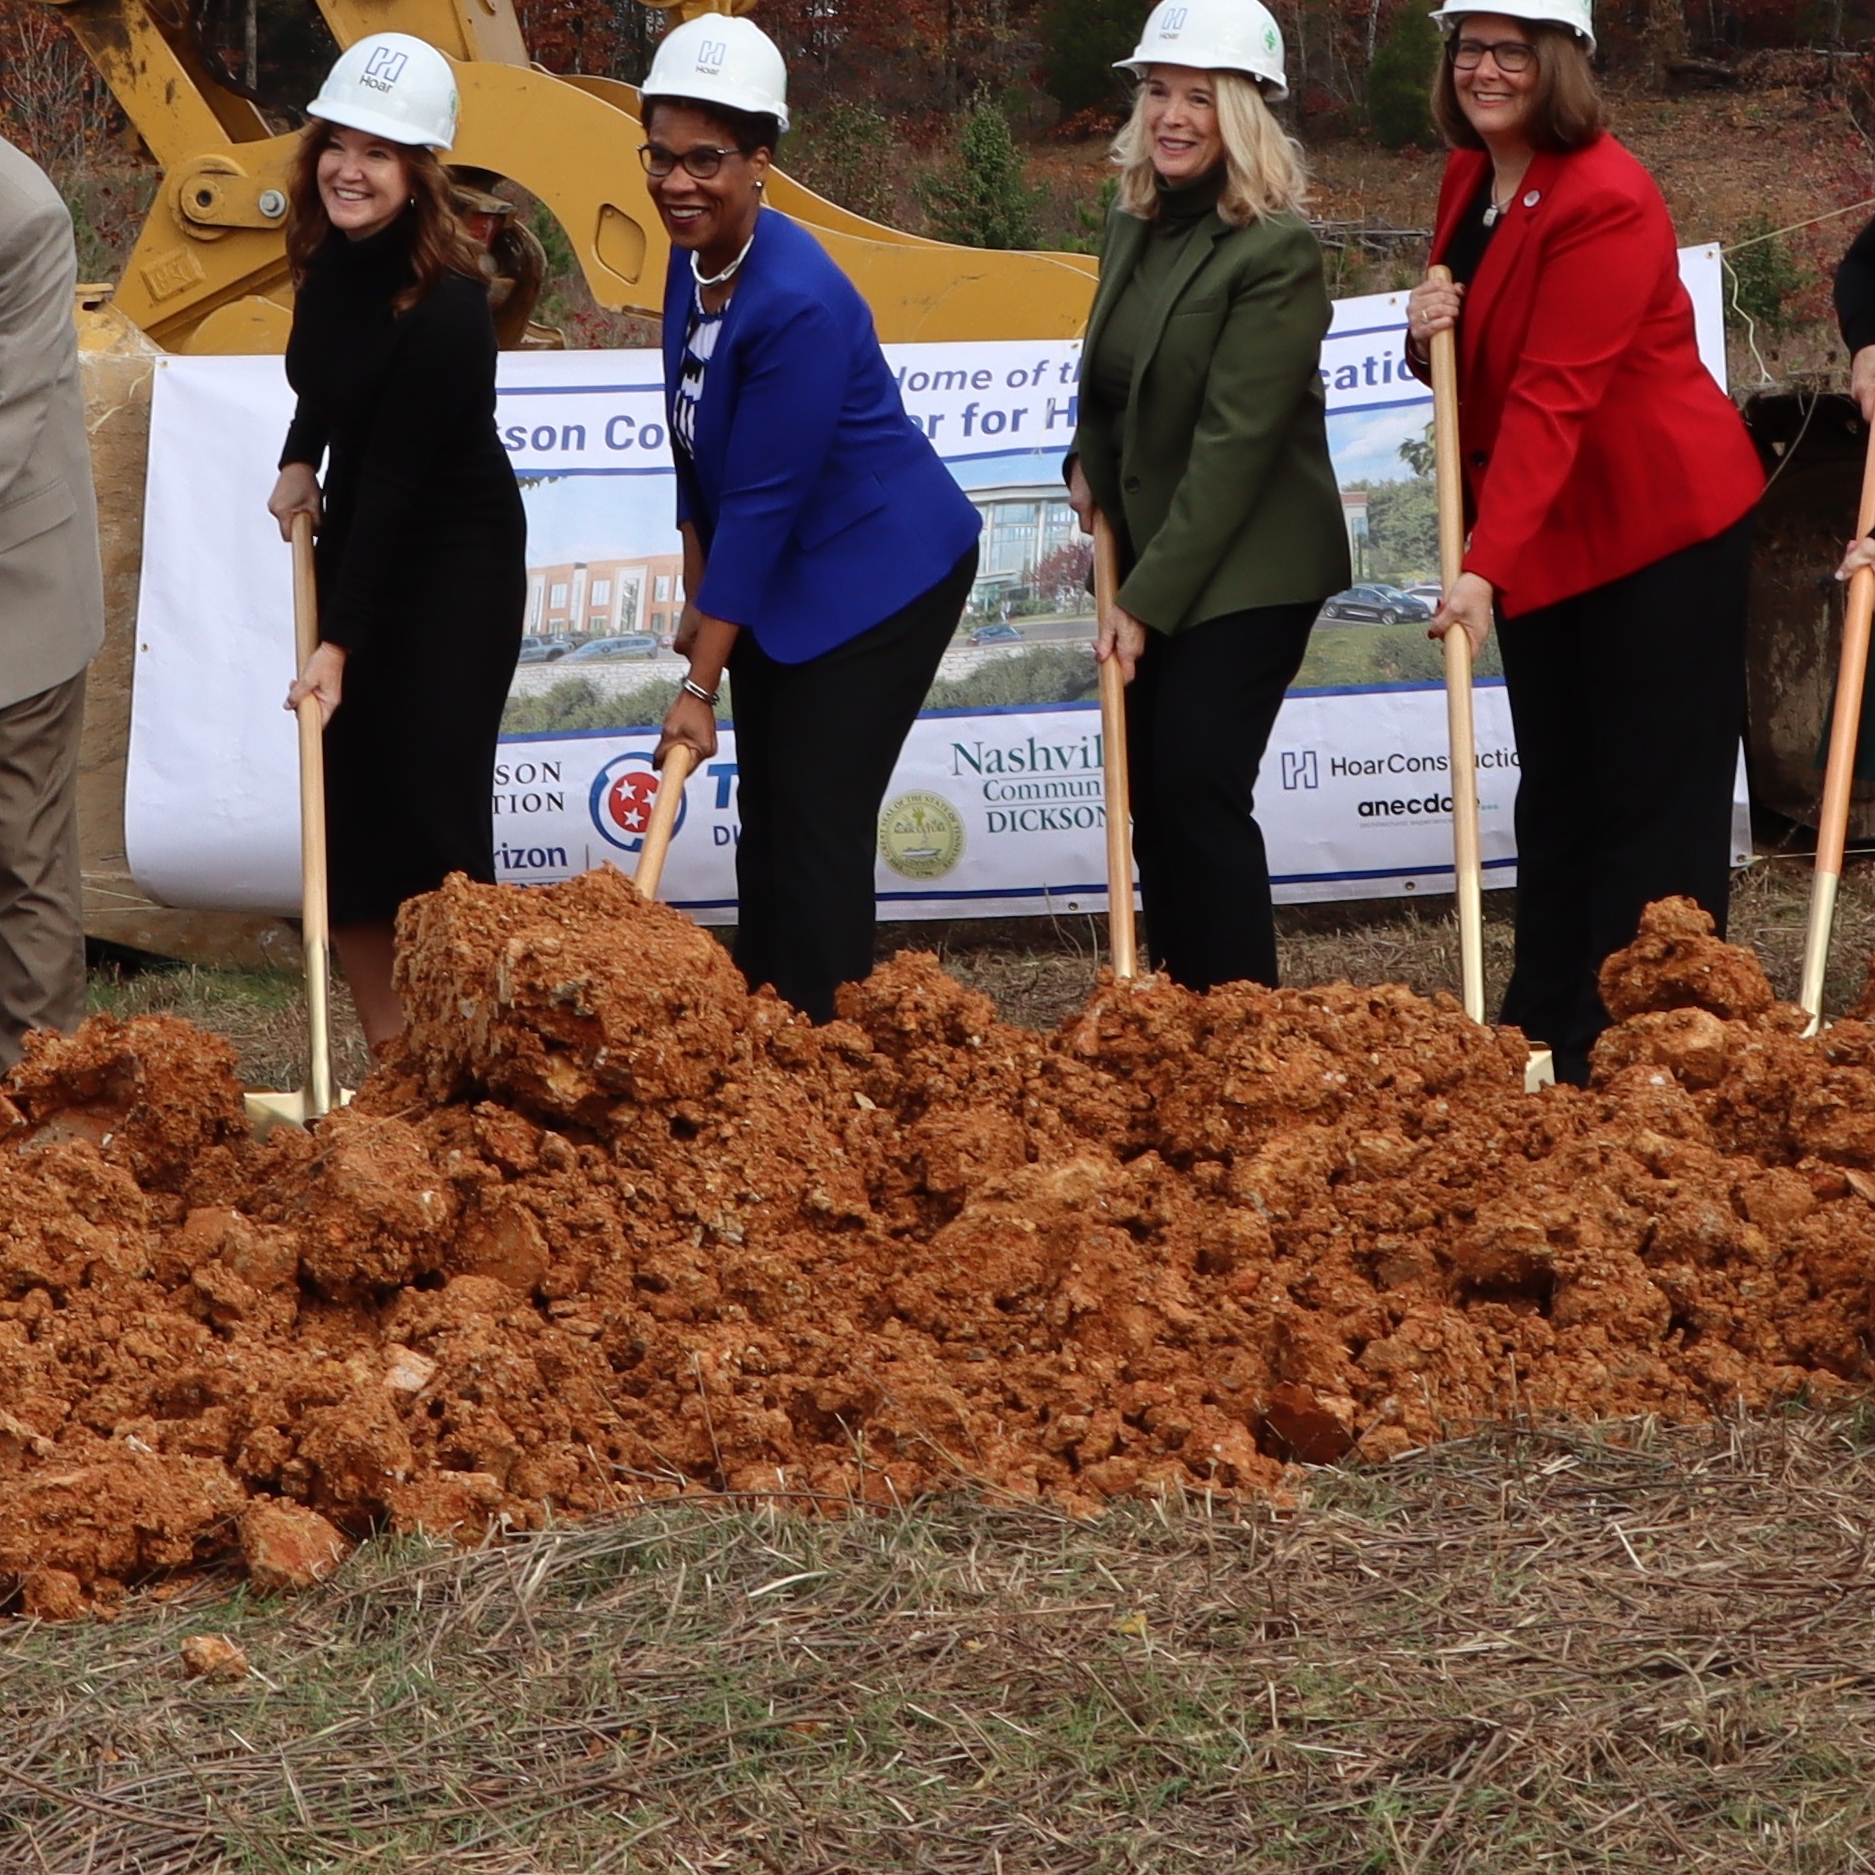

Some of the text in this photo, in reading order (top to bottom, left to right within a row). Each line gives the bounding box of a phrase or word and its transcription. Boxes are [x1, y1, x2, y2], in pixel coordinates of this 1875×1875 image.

[359, 75, 393, 93] Hoar
[1006, 360, 1049, 388] of
[497, 424, 586, 452] son
[961, 402, 1028, 437] for
[1357, 793, 1481, 817] anecdo
